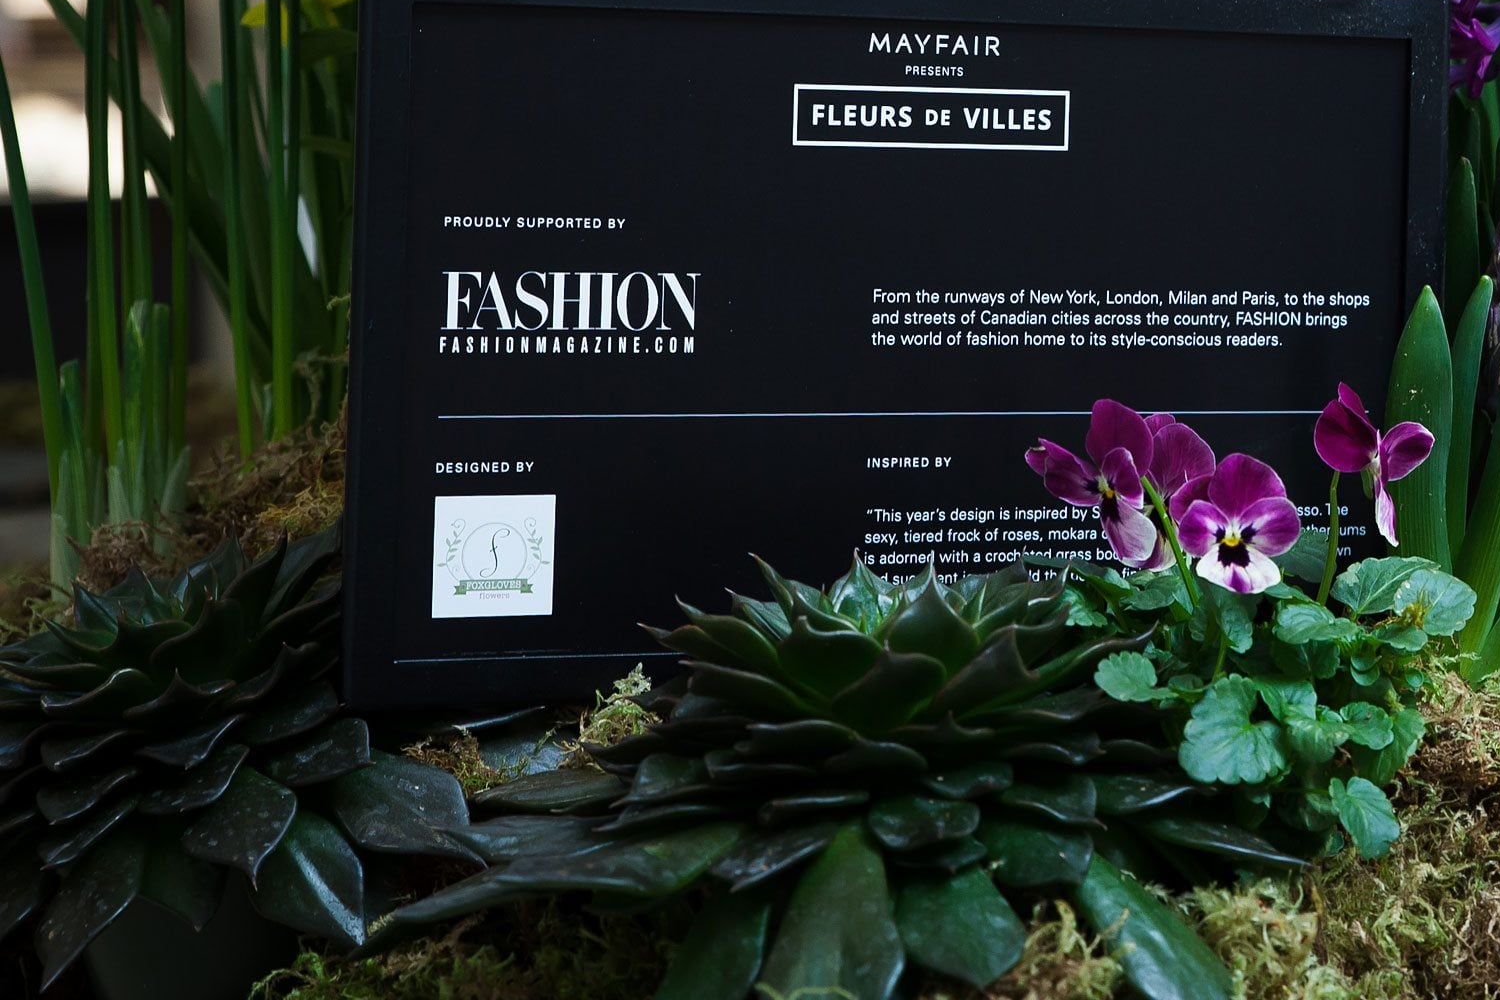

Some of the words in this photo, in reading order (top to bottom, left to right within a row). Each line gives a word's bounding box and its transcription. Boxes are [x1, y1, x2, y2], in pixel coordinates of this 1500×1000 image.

[869, 32, 1000, 56] MAYFAIR
[905, 65, 964, 77] PRESENTS
[812, 104, 912, 127] FLEURS
[925, 109, 951, 126] DE
[963, 107, 1051, 130] VILLES
[444, 216, 511, 228] PROUDLY
[517, 217, 601, 229] SUPPORTED
[608, 218, 625, 229] BY
[441, 271, 701, 331] FASHION
[873, 288, 910, 303] From
[915, 289, 940, 304] the
[945, 292, 1005, 307] runways
[1010, 289, 1025, 304] of
[1030, 289, 1064, 304] New
[1066, 289, 1100, 306] York,
[1106, 290, 1163, 307] London,
[1169, 290, 1207, 305] Milan
[1211, 291, 1237, 305] and
[1242, 291, 1279, 307] Paris,
[1284, 293, 1298, 306] to
[1302, 291, 1325, 306] the
[1329, 291, 1370, 309] shops
[872, 310, 899, 324] and
[904, 312, 956, 325] streets
[961, 310, 976, 325] of
[980, 310, 1047, 325] Canadian
[1051, 310, 1090, 325] cities
[1094, 314, 1141, 325] across
[1146, 311, 1169, 325] the
[1174, 313, 1230, 329] country,
[1236, 311, 1301, 326] FASHION
[1305, 312, 1348, 329] brings
[439, 336, 694, 353] FASHIONMAGAZINE.COM
[871, 331, 895, 346] the
[900, 331, 942, 346] world
[947, 331, 962, 346] of
[966, 331, 1019, 346] fashion
[1024, 331, 1065, 346] home
[1070, 333, 1085, 346] to
[1089, 331, 1107, 346] its
[1111, 332, 1222, 349] style-conscious
[1226, 332, 1282, 346] readers.
[436, 462, 510, 473] DESIGNED
[516, 461, 534, 472] BY
[867, 457, 929, 468] INSPIRED
[935, 457, 951, 467] BY
[950, 507, 995, 523] design
[999, 507, 1010, 520] is
[1015, 506, 1068, 522] inspired
[1072, 506, 1088, 522] by
[864, 533, 898, 546] sexy,
[904, 529, 943, 543] tiered
[947, 528, 980, 542] frock
[985, 528, 999, 542] of
[1003, 530, 1043, 542] roses,
[1048, 527, 1097, 540] mokara
[864, 551, 875, 565] is
[939, 550, 969, 563] with
[973, 552, 981, 563] a
[466, 580, 520, 590] FOXGLOVES
